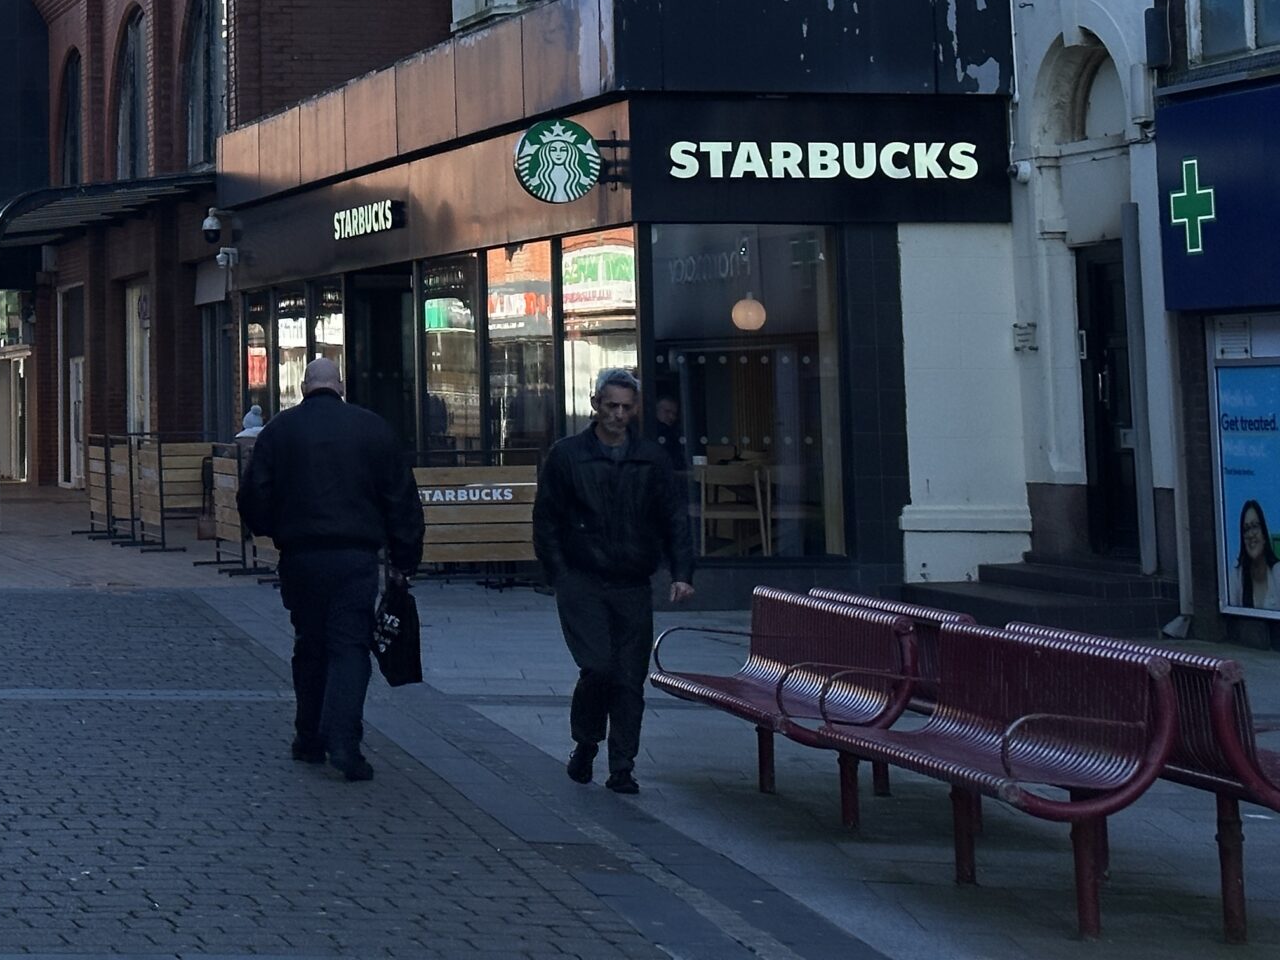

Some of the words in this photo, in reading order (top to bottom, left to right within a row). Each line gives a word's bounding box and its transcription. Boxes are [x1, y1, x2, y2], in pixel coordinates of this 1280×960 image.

[669, 141, 979, 180] STARBUCKS
[333, 199, 393, 240] STARBUCKS
[1221, 413, 1240, 431] Get
[1240, 413, 1279, 431] treated.
